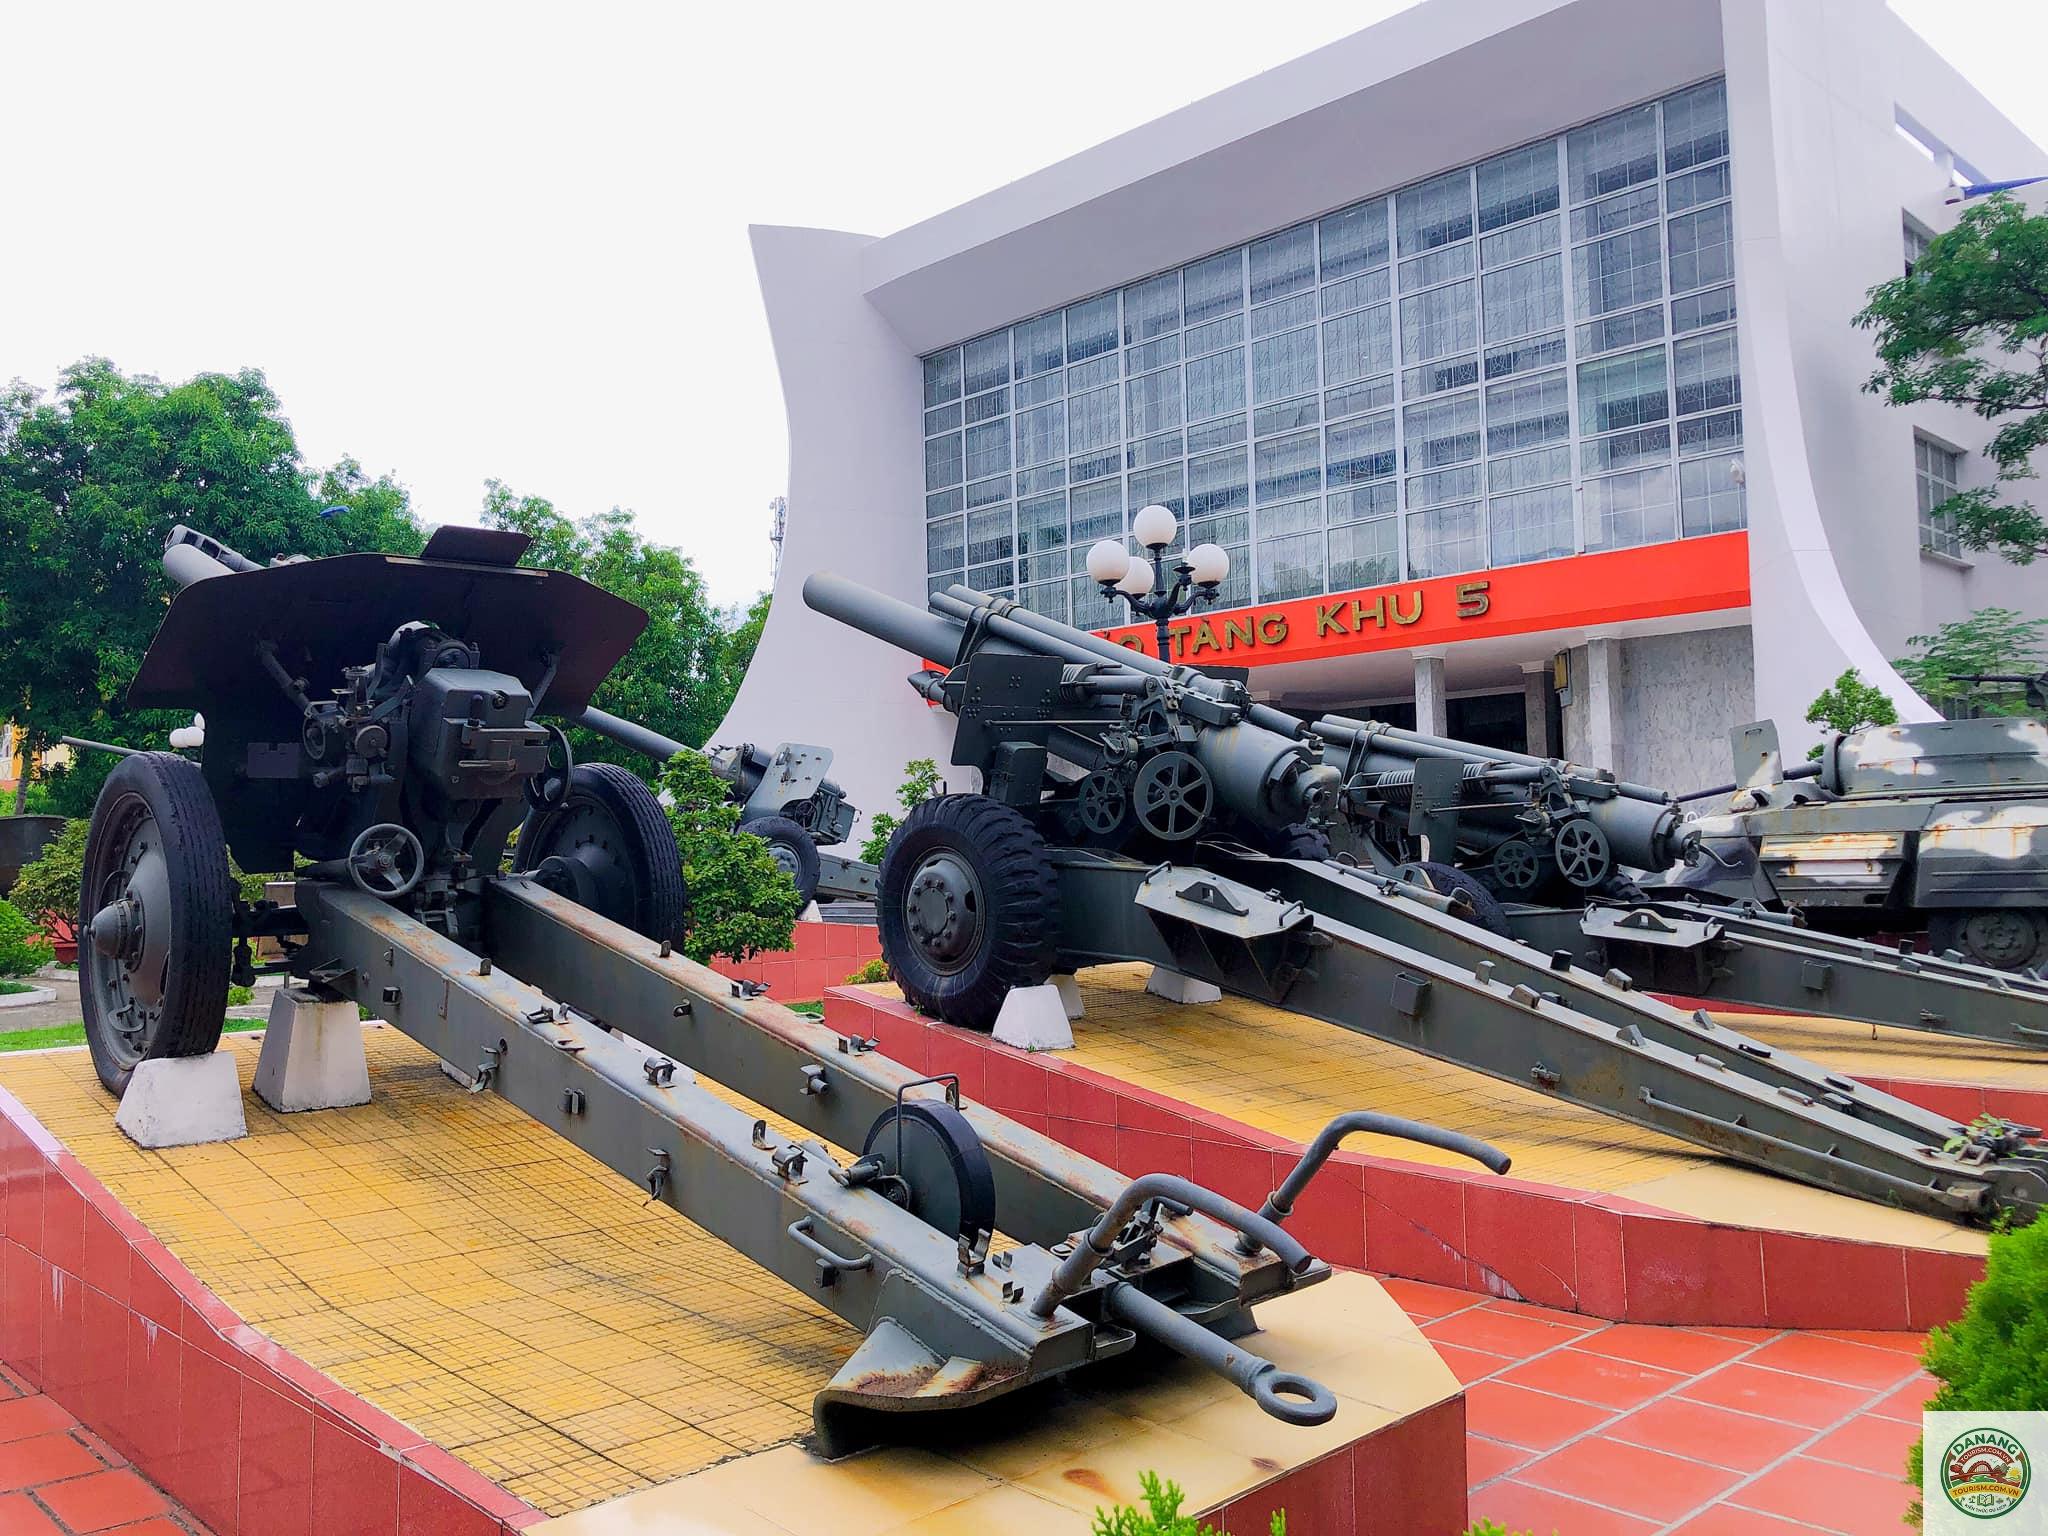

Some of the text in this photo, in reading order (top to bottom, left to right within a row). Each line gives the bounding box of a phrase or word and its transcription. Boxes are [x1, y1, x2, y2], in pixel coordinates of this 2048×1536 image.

[1168, 612, 1289, 657] TÀNG
[1315, 590, 1425, 637] KHU
[1455, 581, 1490, 618] 5
